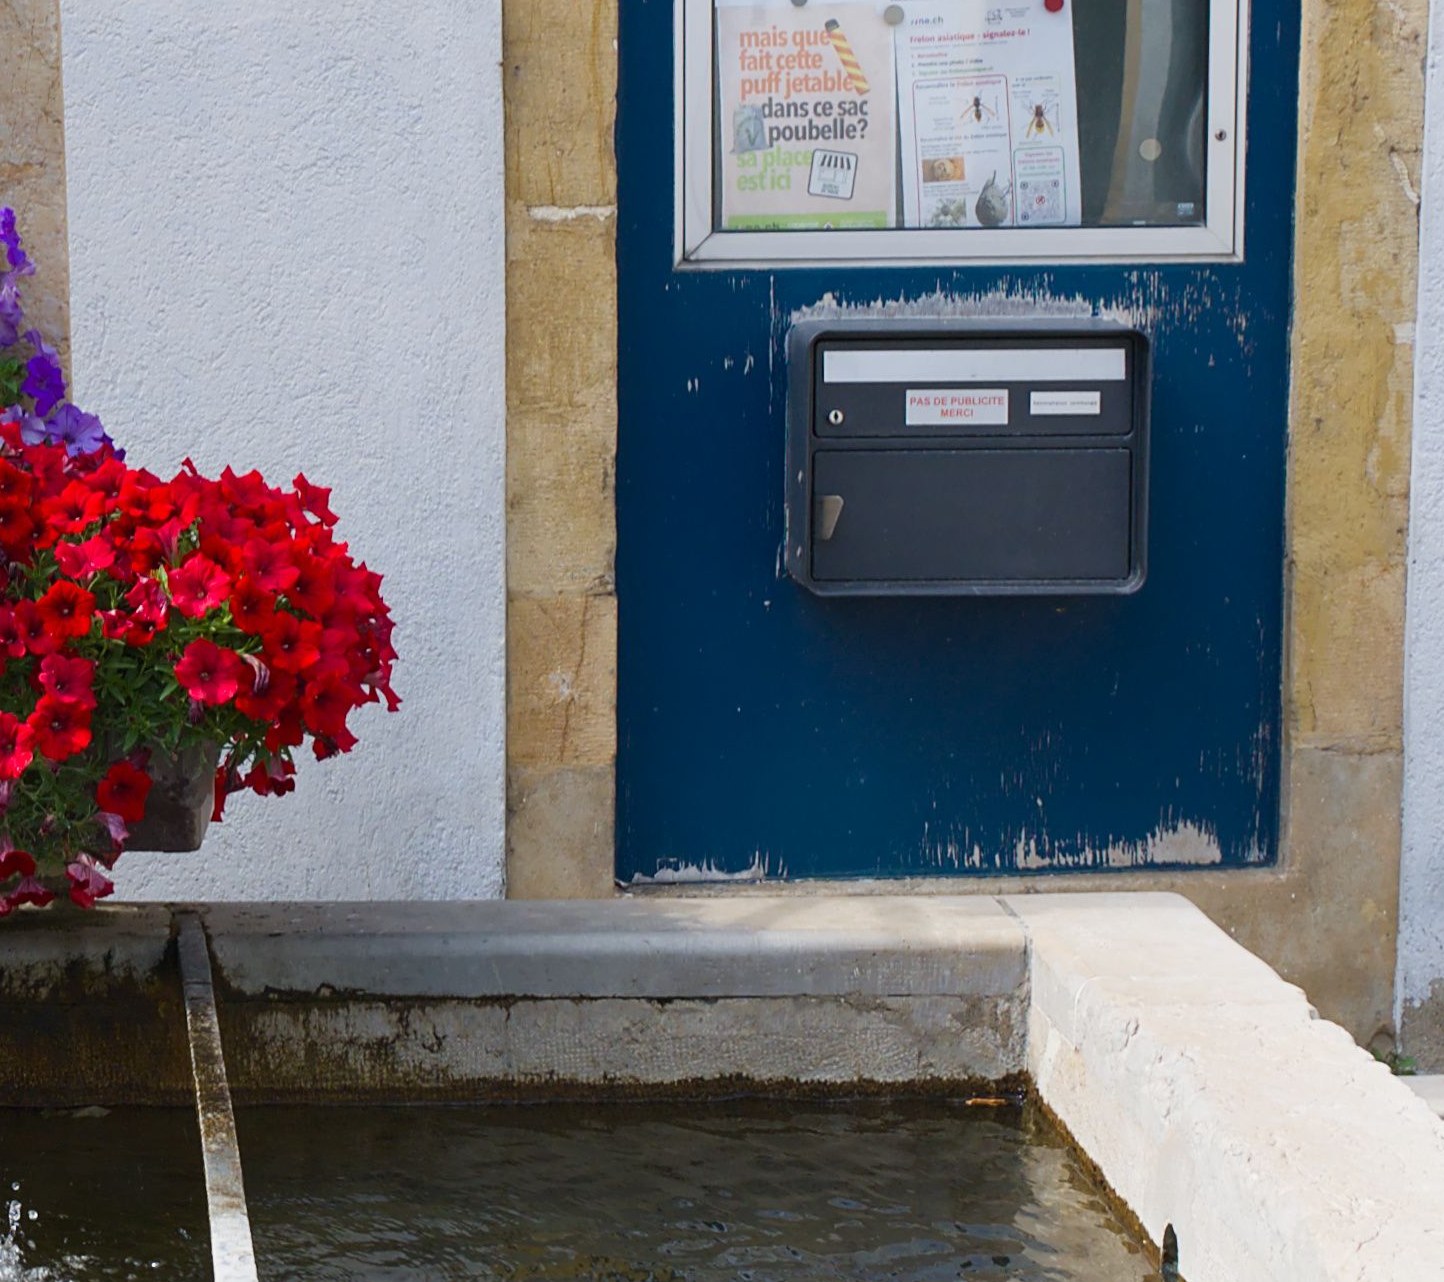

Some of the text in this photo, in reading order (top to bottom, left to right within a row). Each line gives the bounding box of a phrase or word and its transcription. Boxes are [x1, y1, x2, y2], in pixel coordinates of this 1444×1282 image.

[739, 26, 831, 52] mais que
[909, 35, 936, 44] Frelon
[937, 32, 975, 43] asiatique
[982, 29, 1026, 40] signalez-le
[739, 48, 823, 71] fait cette
[740, 70, 854, 101] puff jetable
[762, 97, 869, 118] dans ce sac
[768, 118, 869, 148] poubelle?
[737, 145, 813, 173] sa place
[737, 168, 791, 191] est ici
[909, 396, 1005, 406] PAS DE PUBLICITE
[940, 408, 974, 418] MERCI
